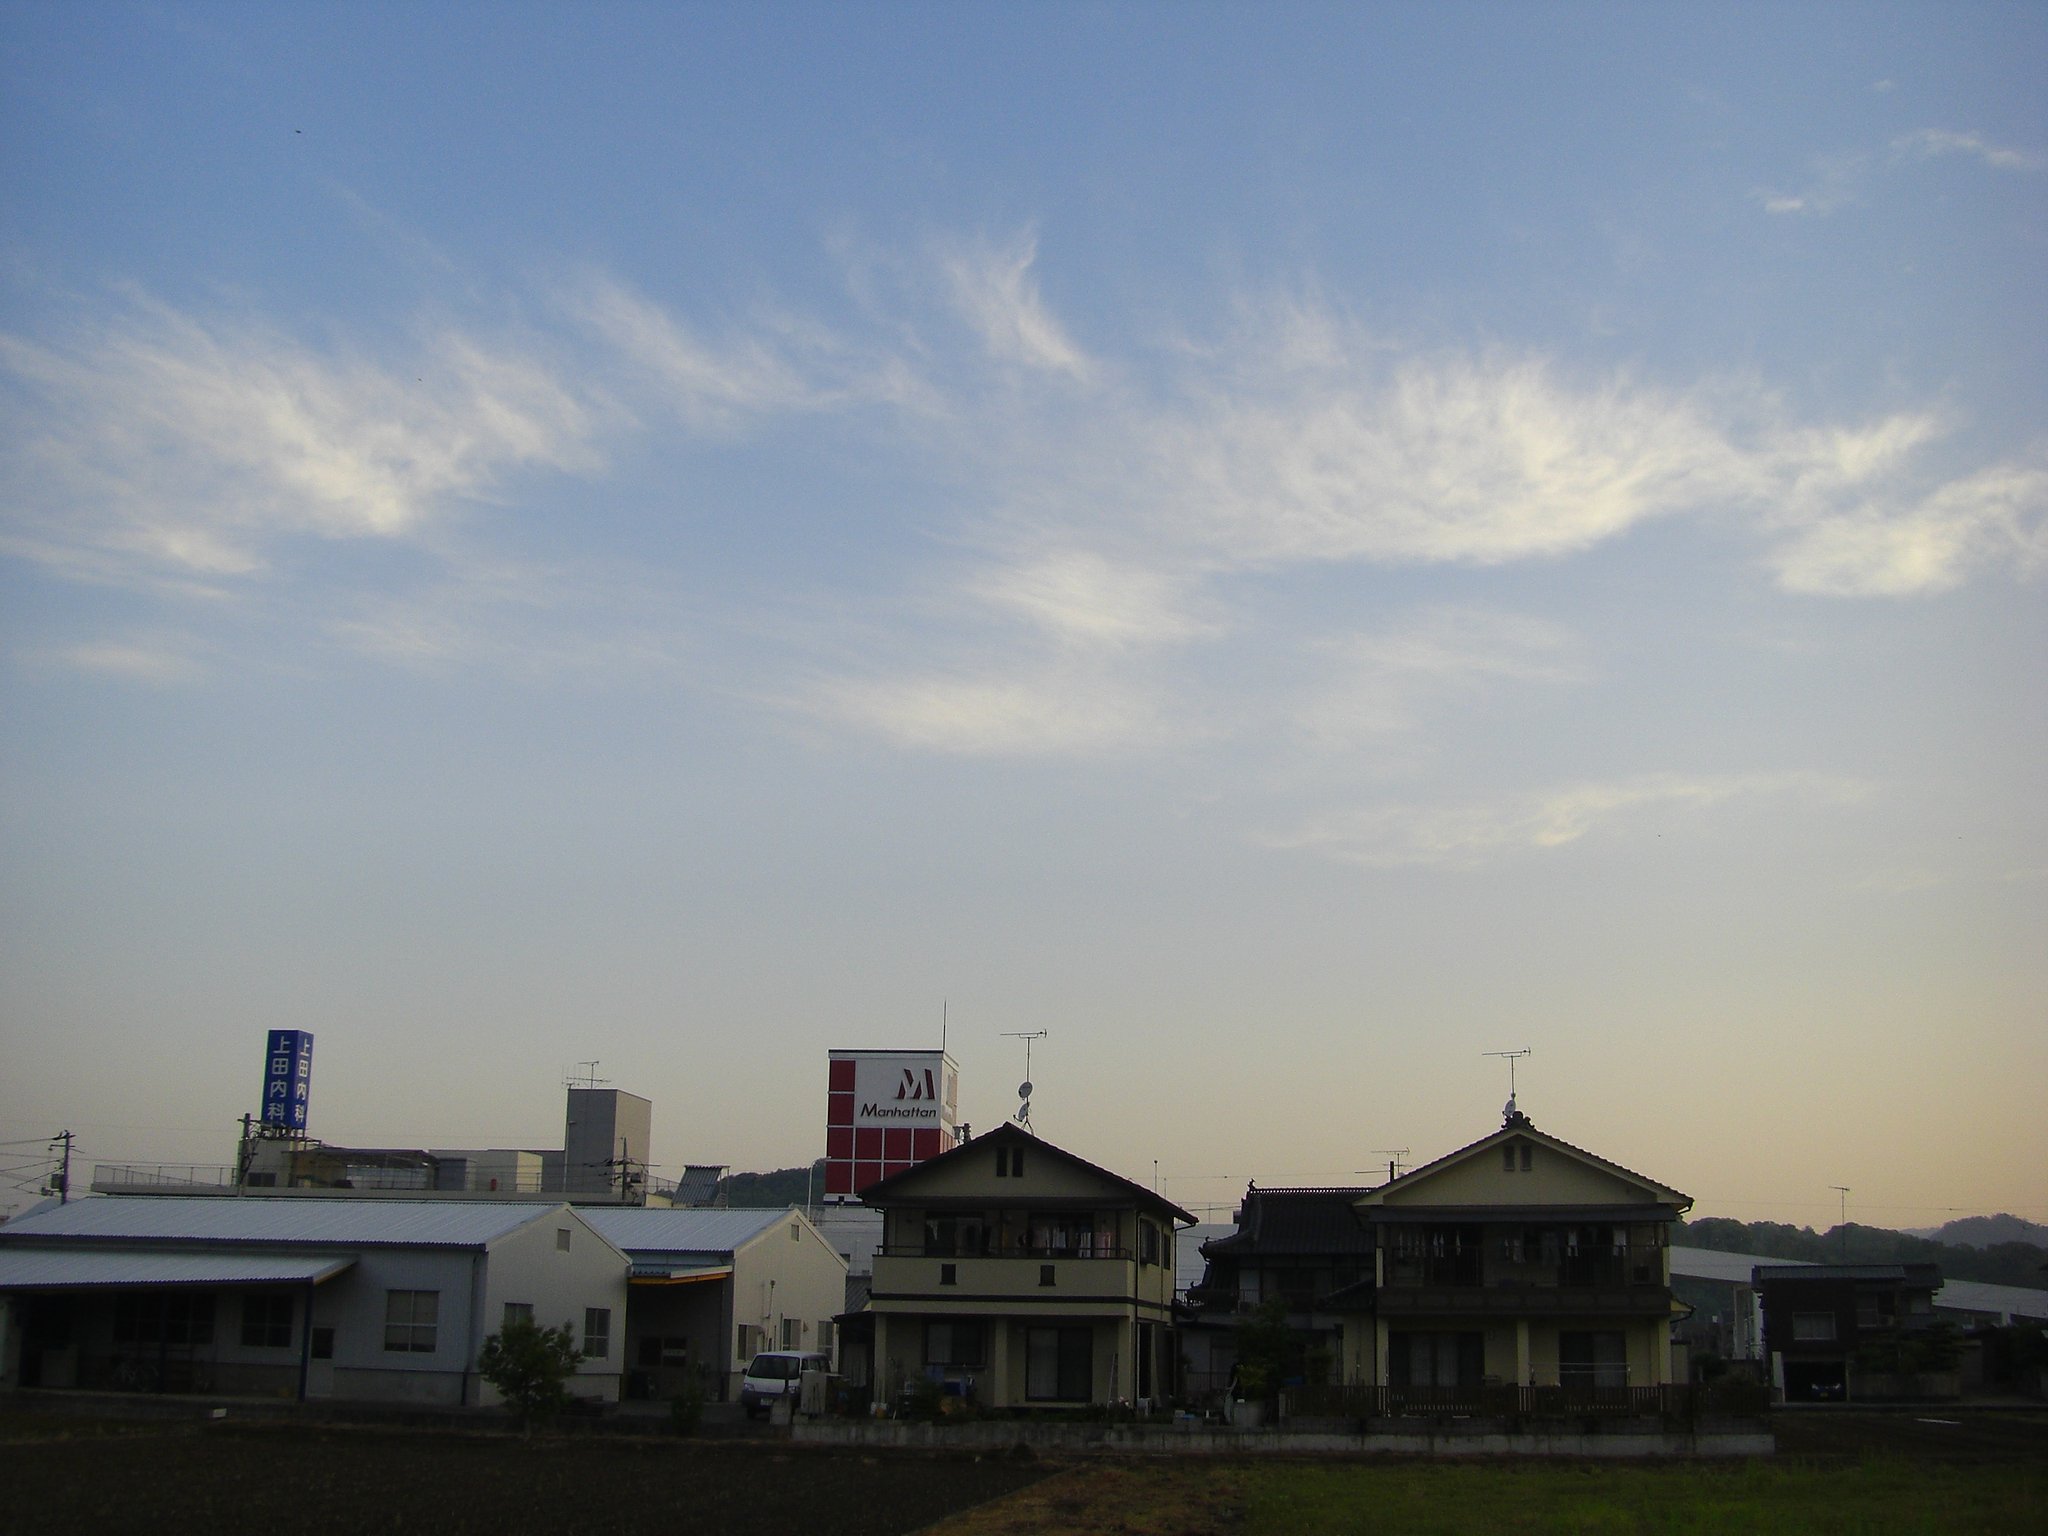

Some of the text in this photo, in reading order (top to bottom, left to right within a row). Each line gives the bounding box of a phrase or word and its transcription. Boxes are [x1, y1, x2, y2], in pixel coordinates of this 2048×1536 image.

[267, 1035, 291, 1120] 上田内科
[294, 1038, 311, 1123] 上田内科
[860, 1103, 937, 1118] Manhattan
